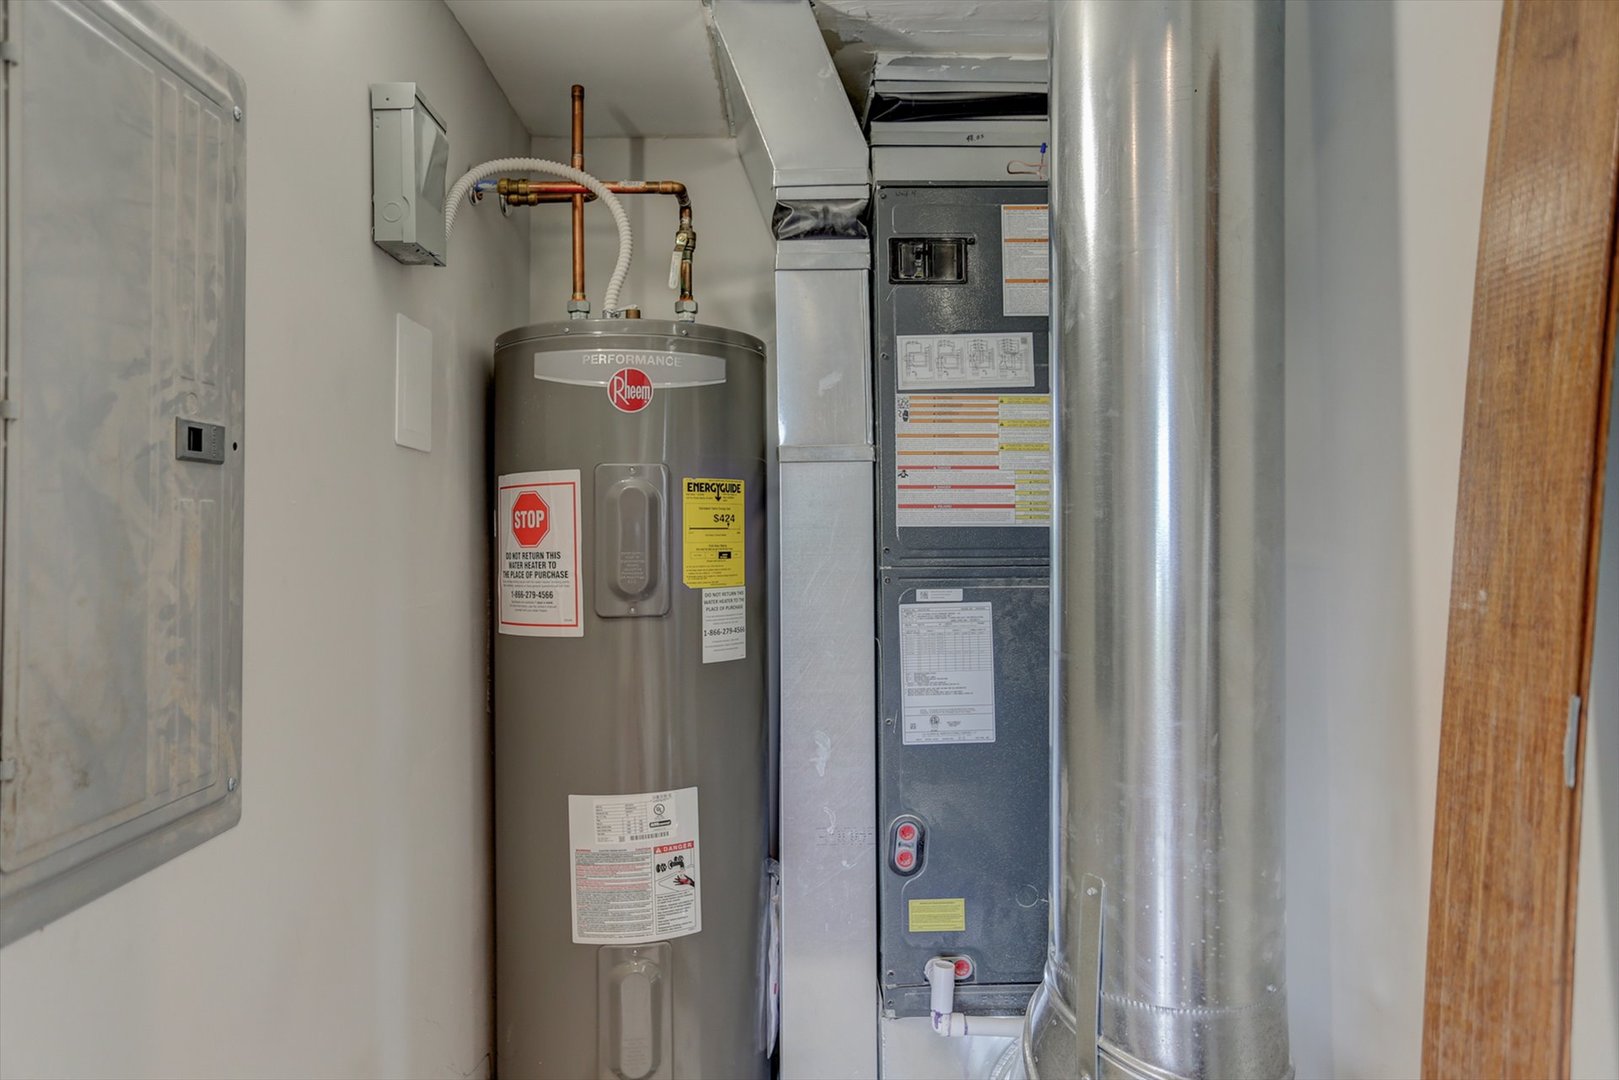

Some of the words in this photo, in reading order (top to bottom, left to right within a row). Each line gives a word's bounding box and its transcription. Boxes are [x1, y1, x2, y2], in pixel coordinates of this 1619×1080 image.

[582, 353, 682, 367] PERFORMANCE
[613, 368, 651, 406] Rheem
[687, 482, 742, 495] ENERGYGUIDE
[514, 509, 545, 529] STOP
[506, 552, 511, 560] DO
[512, 552, 521, 560] NOT
[522, 551, 545, 560] RETURN
[546, 551, 561, 560] THIS
[509, 561, 523, 569] WATER
[524, 561, 547, 569] HEATER
[548, 561, 557, 569] TO
[510, 570, 525, 579] PLACE
[525, 570, 533, 579] OF
[534, 570, 569, 579] PURCHASE
[511, 590, 554, 600] 1-866-279-4566
[663, 842, 693, 852] DANGER
